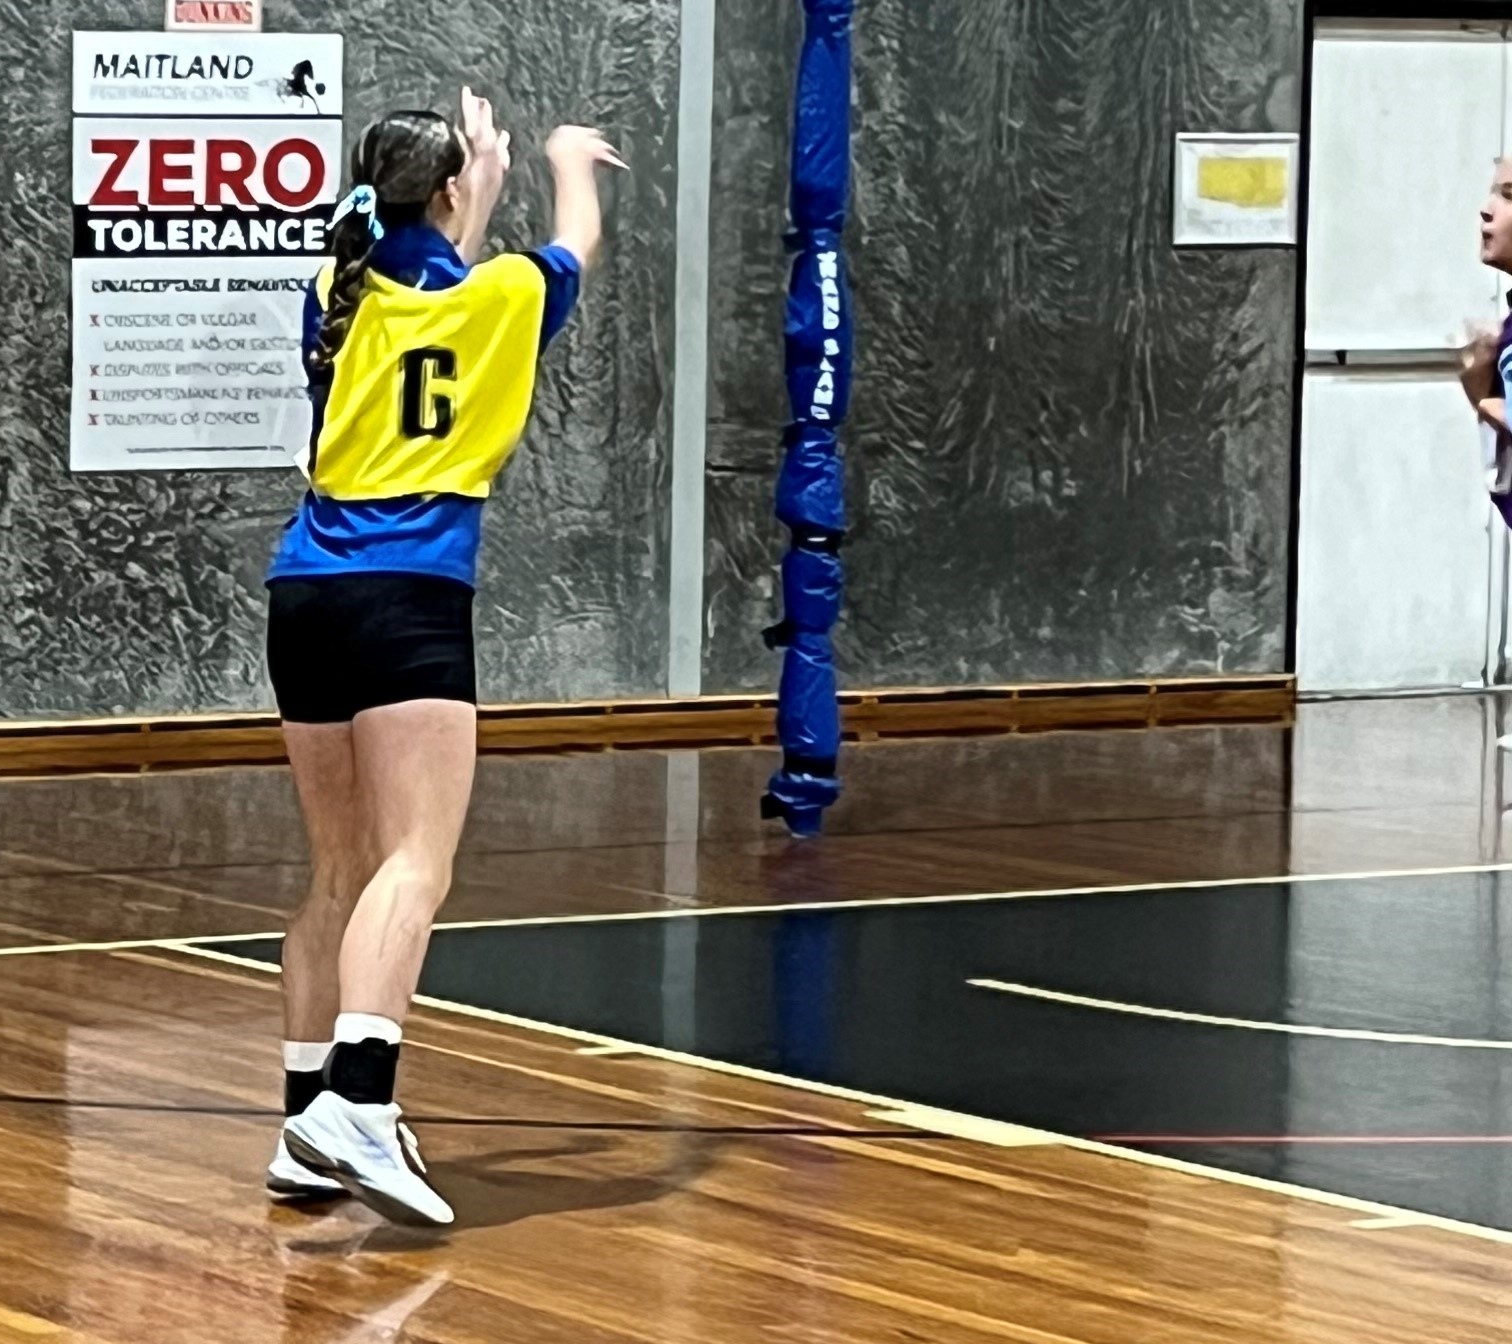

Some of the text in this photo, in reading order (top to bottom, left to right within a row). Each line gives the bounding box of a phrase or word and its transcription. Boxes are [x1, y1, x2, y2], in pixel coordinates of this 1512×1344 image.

[93, 53, 254, 80] MAITLAND
[89, 137, 326, 206] ZERO
[88, 218, 327, 252] TOLERANCE
